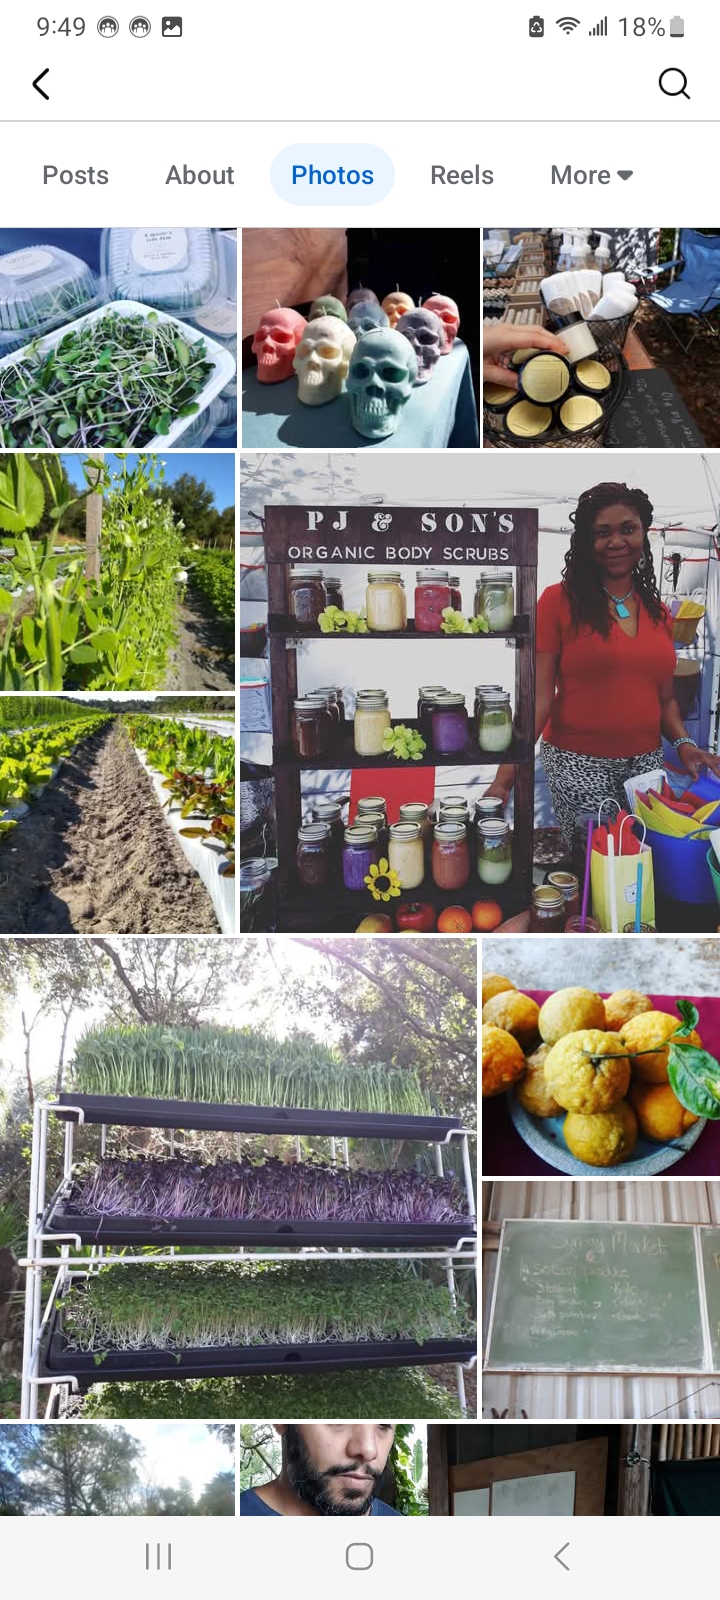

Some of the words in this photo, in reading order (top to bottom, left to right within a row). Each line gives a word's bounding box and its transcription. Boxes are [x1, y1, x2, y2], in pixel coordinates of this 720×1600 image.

[36, 16, 86, 37] 9:49
[618, 16, 666, 37] 18%
[42, 164, 109, 185] Posts
[164, 164, 235, 185] About
[291, 163, 374, 185] Photos
[430, 164, 494, 185] Reels
[550, 164, 611, 185] More
[306, 510, 349, 533] PJ
[371, 511, 393, 533] &
[420, 510, 515, 534] SON'S
[287, 545, 376, 561] ORGANIC
[385, 545, 433, 561] BODY
[443, 546, 510, 561] SCRUBS
